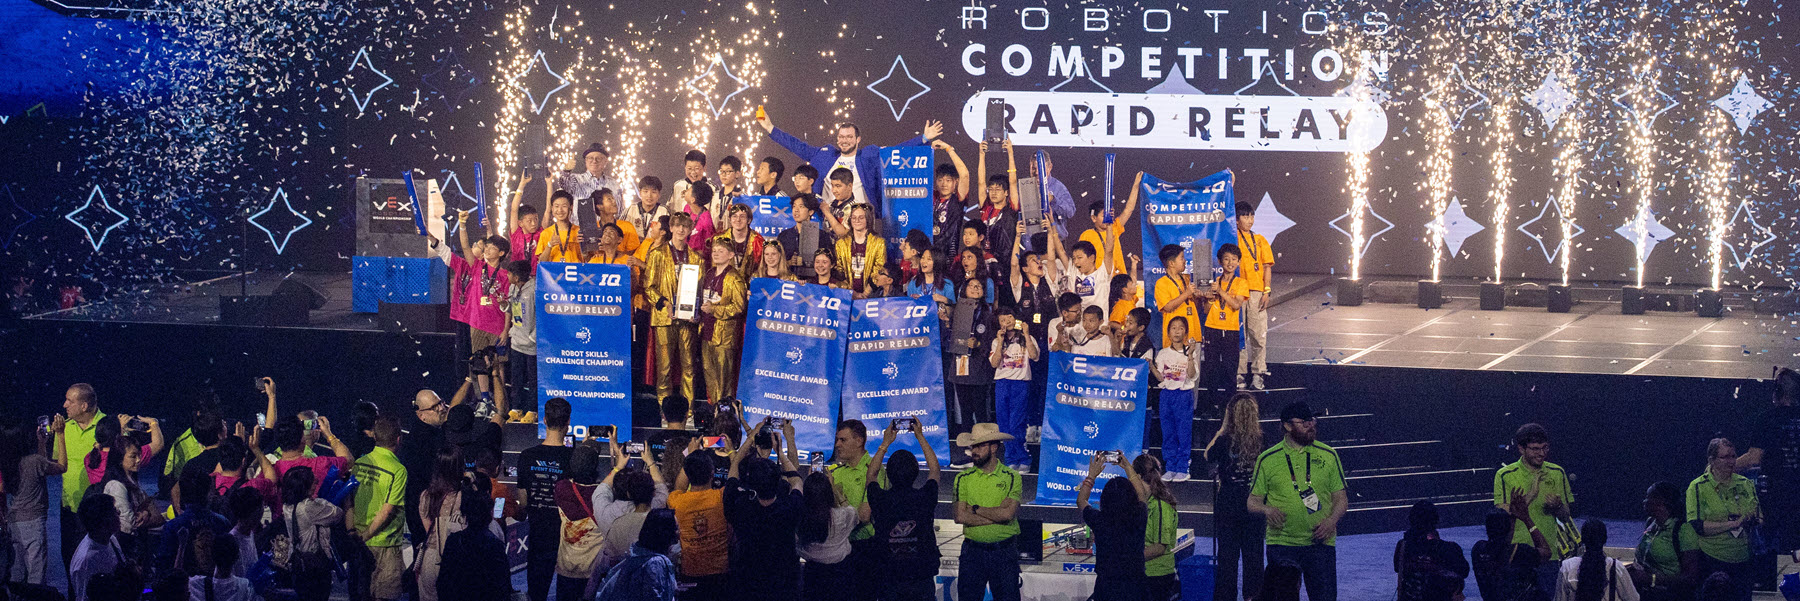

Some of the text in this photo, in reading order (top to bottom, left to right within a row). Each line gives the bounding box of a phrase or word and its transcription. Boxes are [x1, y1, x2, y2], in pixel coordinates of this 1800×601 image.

[962, 6, 1389, 35] ROBOTICS
[961, 43, 1389, 82] COMPETITION
[1188, 106, 1353, 140] RELAY
[880, 149, 928, 169] VEX IQ
[882, 177, 929, 186] OMPETITION
[904, 188, 926, 197] RELAY
[372, 196, 412, 212] VEX
[1145, 201, 1226, 213] COMPETITION
[1150, 212, 1221, 223] RAPID RELAY
[545, 265, 622, 287] VEX IQ
[543, 293, 623, 303] COMPETITION
[760, 282, 842, 311] VEX IQ
[549, 305, 617, 315] RAPID RELAY
[903, 305, 929, 319] IQ
[756, 308, 840, 328] COMPETITION
[761, 320, 834, 341] RAPID RELAY
[847, 325, 931, 340] COMPETITION
[853, 338, 926, 351] RAPID RELAY
[561, 349, 609, 358] ROBOT SKILLS
[545, 357, 624, 367] CHALLENGE CHAMPION
[1059, 356, 1139, 381] VEX IQ
[562, 374, 584, 382] MIDDLE
[754, 368, 829, 386] EXCELLENCE AWARD
[573, 391, 626, 399] CHAMPIONSHIP
[856, 386, 930, 399] EXCELLENCE AWARD
[1056, 381, 1138, 399] COMPETITION
[763, 392, 815, 406] MIDDLE SCHOOL
[1060, 394, 1131, 410] RAPID RELAY
[743, 405, 830, 425] WORLD CHAMPIONSHIP
[861, 409, 929, 420] ELEMENTARY SCHOOL
[866, 429, 880, 437] RLD
[1057, 444, 1082, 455] WORLD
[1056, 466, 1090, 478] ELEMENTA
[1046, 481, 1072, 492] WORLD
[1066, 564, 1090, 573] VEX
